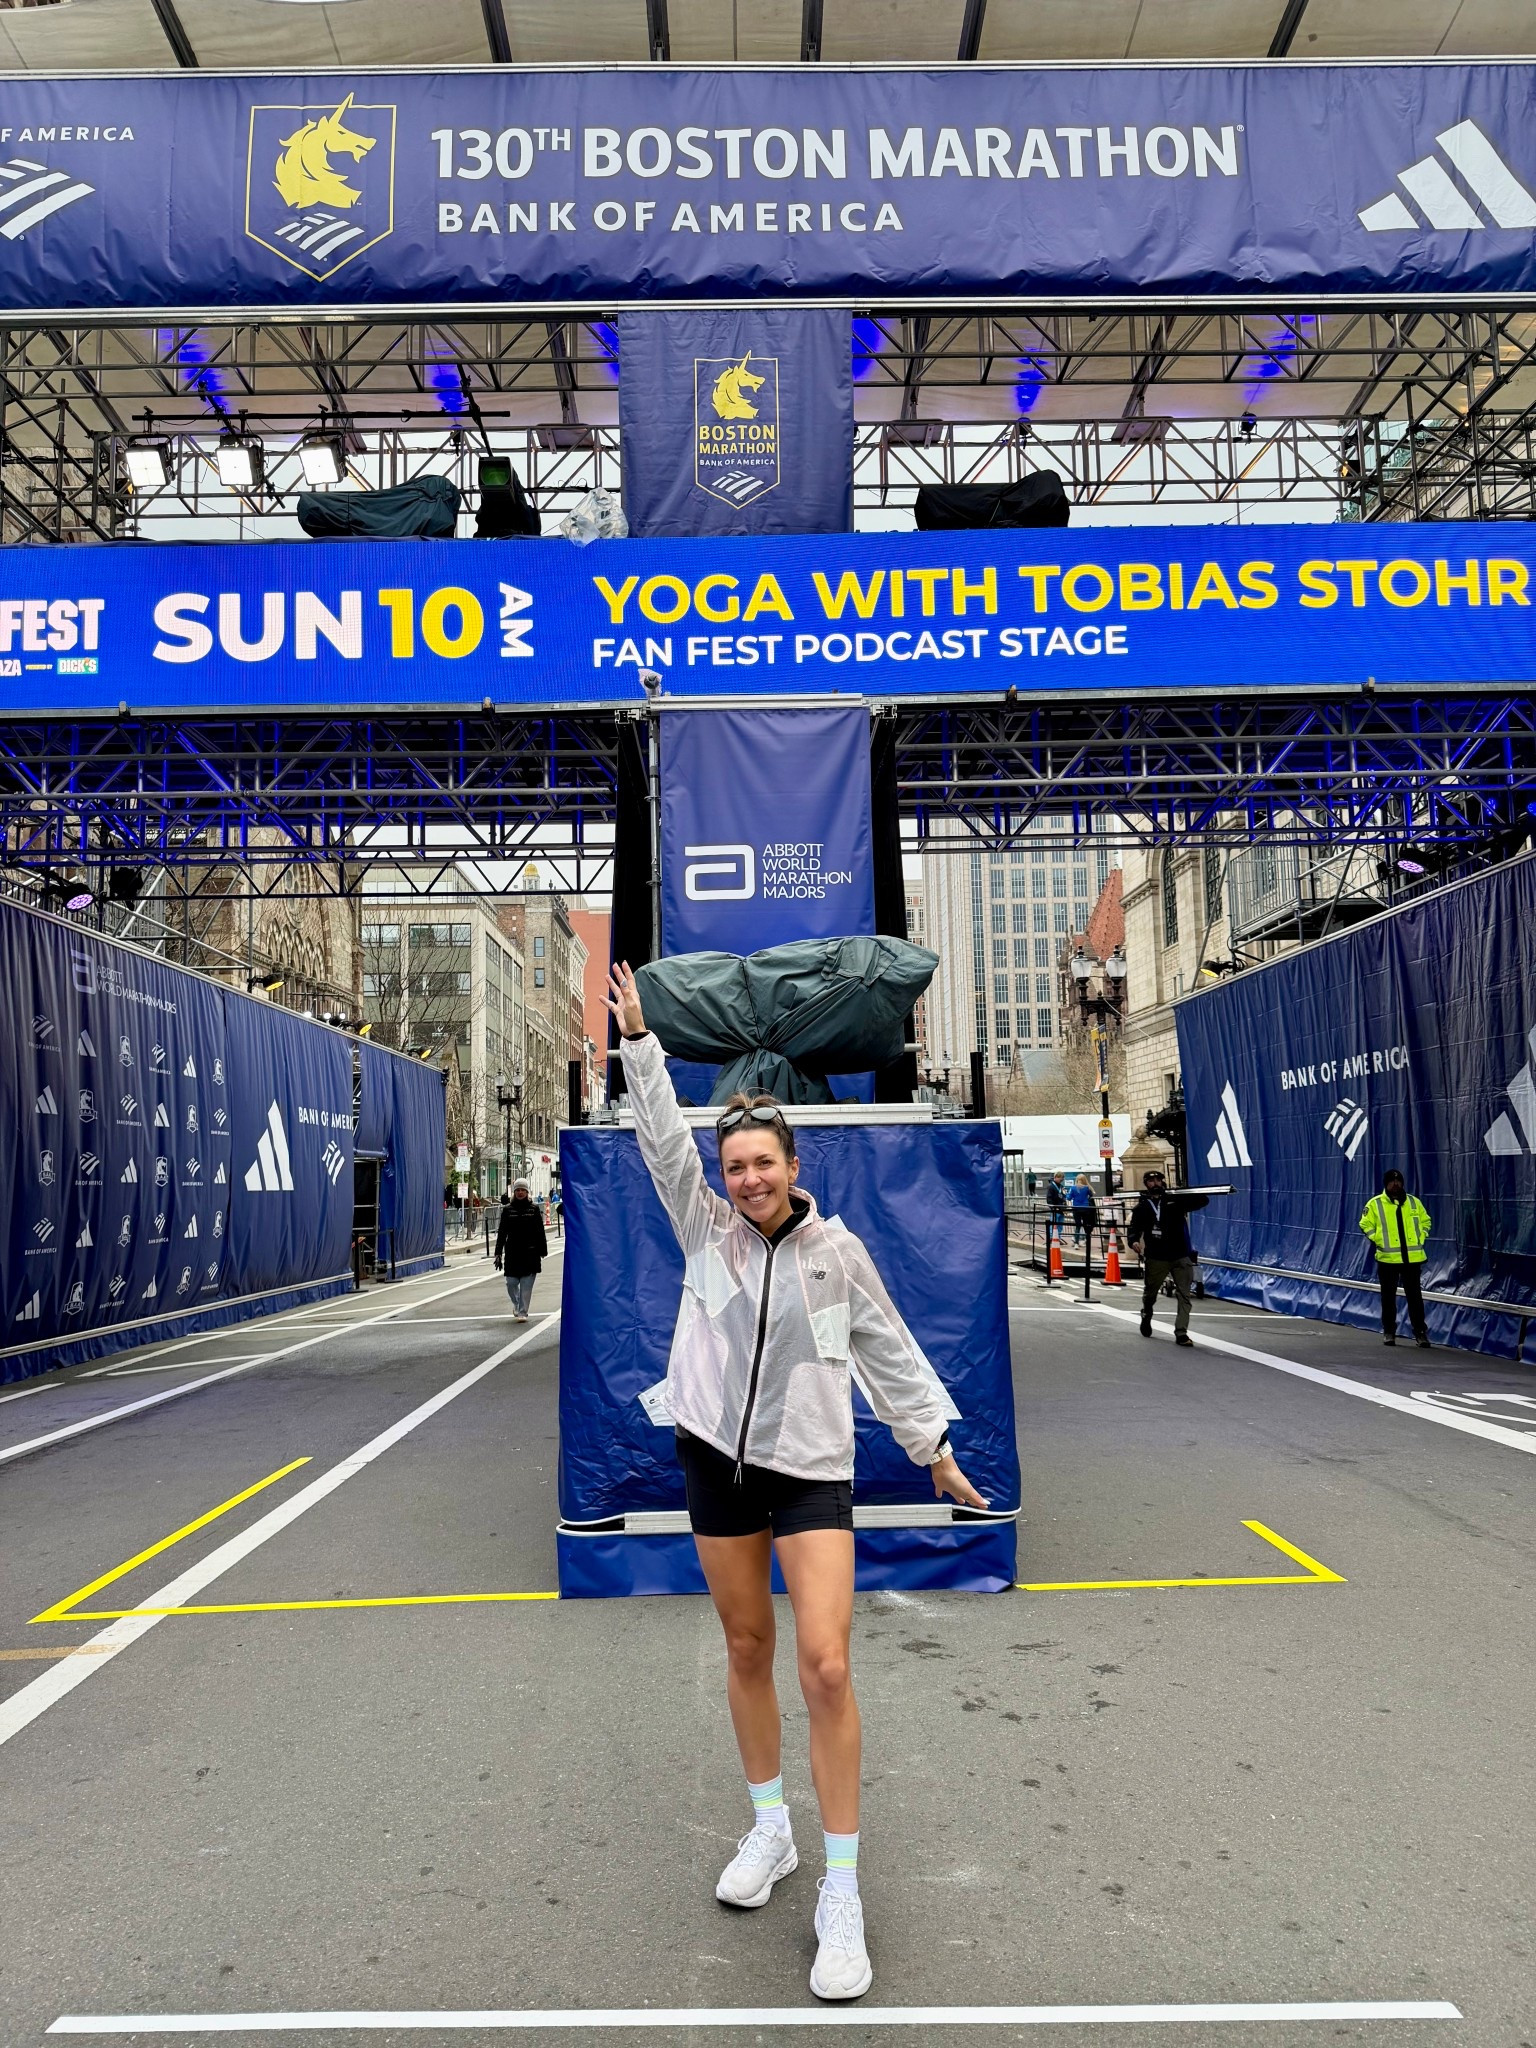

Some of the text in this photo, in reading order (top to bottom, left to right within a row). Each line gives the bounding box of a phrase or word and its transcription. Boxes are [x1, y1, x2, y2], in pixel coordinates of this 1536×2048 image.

[0, 127, 135, 142] F AMERICA
[431, 126, 1238, 180] 130TH BOSTON MARATHON
[438, 201, 904, 234] BANK OF AMERICA
[699, 424, 775, 441] BOSTON
[699, 442, 776, 455] MARATHON
[700, 459, 723, 467] BANK
[592, 559, 1532, 624] YOGA WITH TOBIAS STOHR
[0, 598, 105, 652] FEST
[152, 581, 535, 664] SUN 10 AM
[592, 625, 1129, 668] FAN FEST PODCAST STAGE
[762, 843, 824, 857] ABBOTT
[762, 858, 821, 871] WORLD
[763, 871, 852, 885] MARATHON
[763, 886, 826, 899] MAJORS
[1281, 1045, 1410, 1090] BANK OF AMERICA
